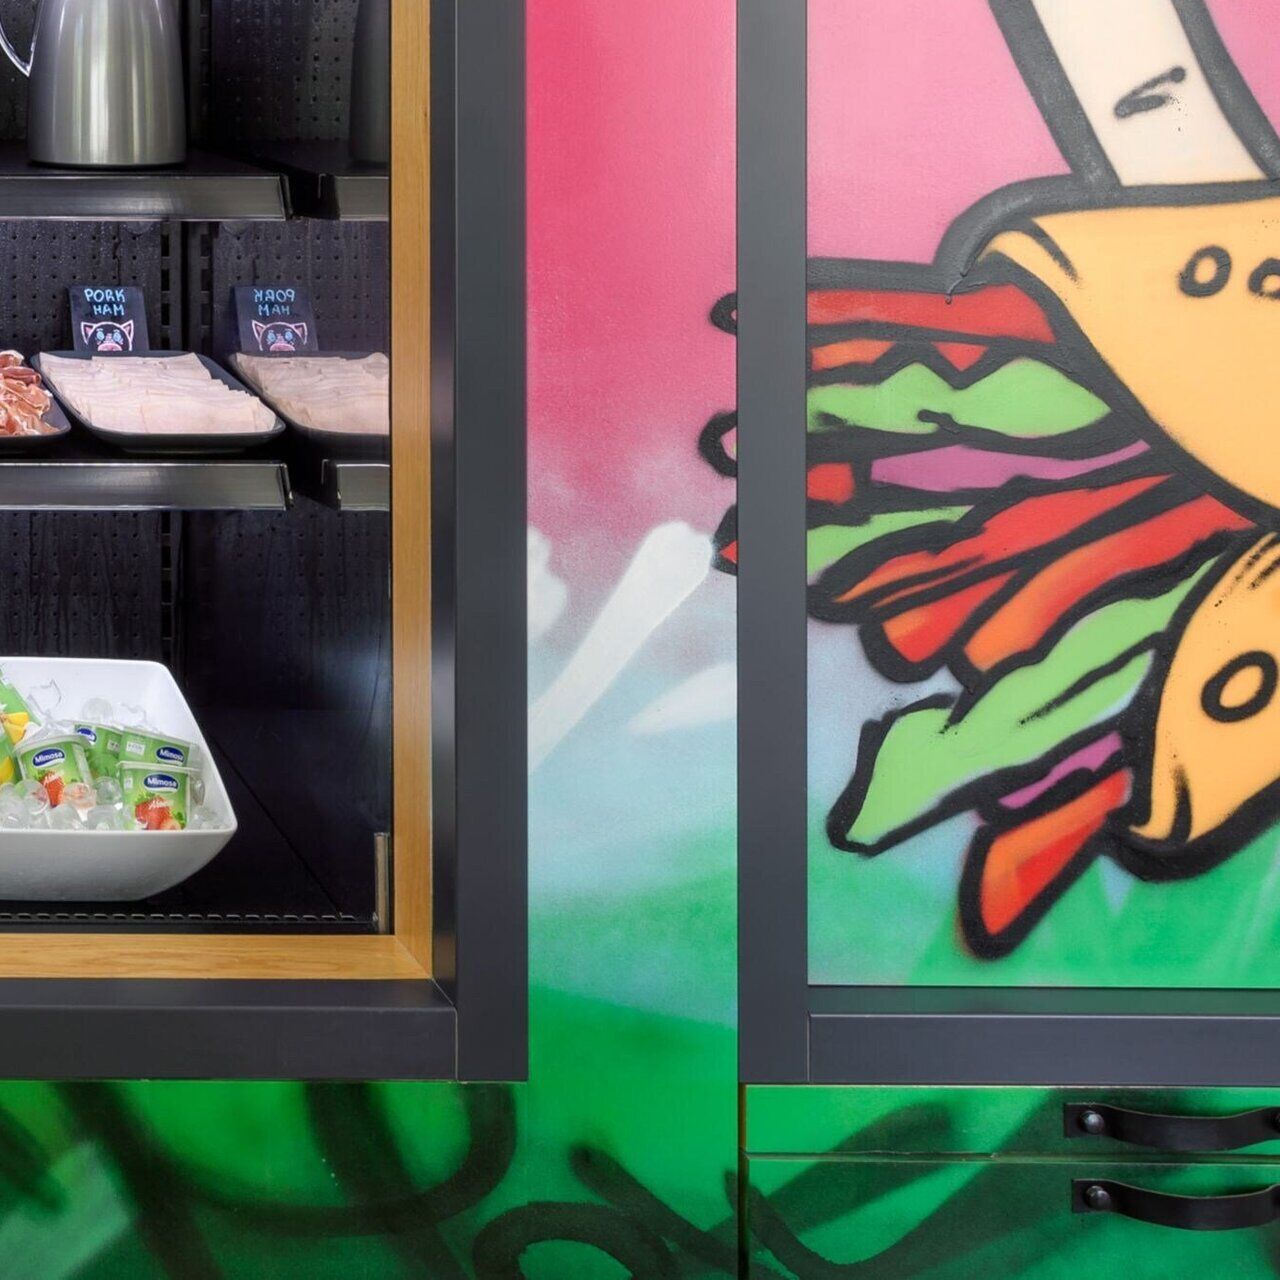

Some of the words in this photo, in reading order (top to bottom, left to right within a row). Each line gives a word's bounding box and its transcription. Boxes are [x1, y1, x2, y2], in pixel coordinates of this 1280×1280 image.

[84, 288, 126, 303] PORK
[92, 304, 125, 316] HAM
[34, 751, 64, 764] Mimosa
[146, 776, 178, 787] Mimosa
